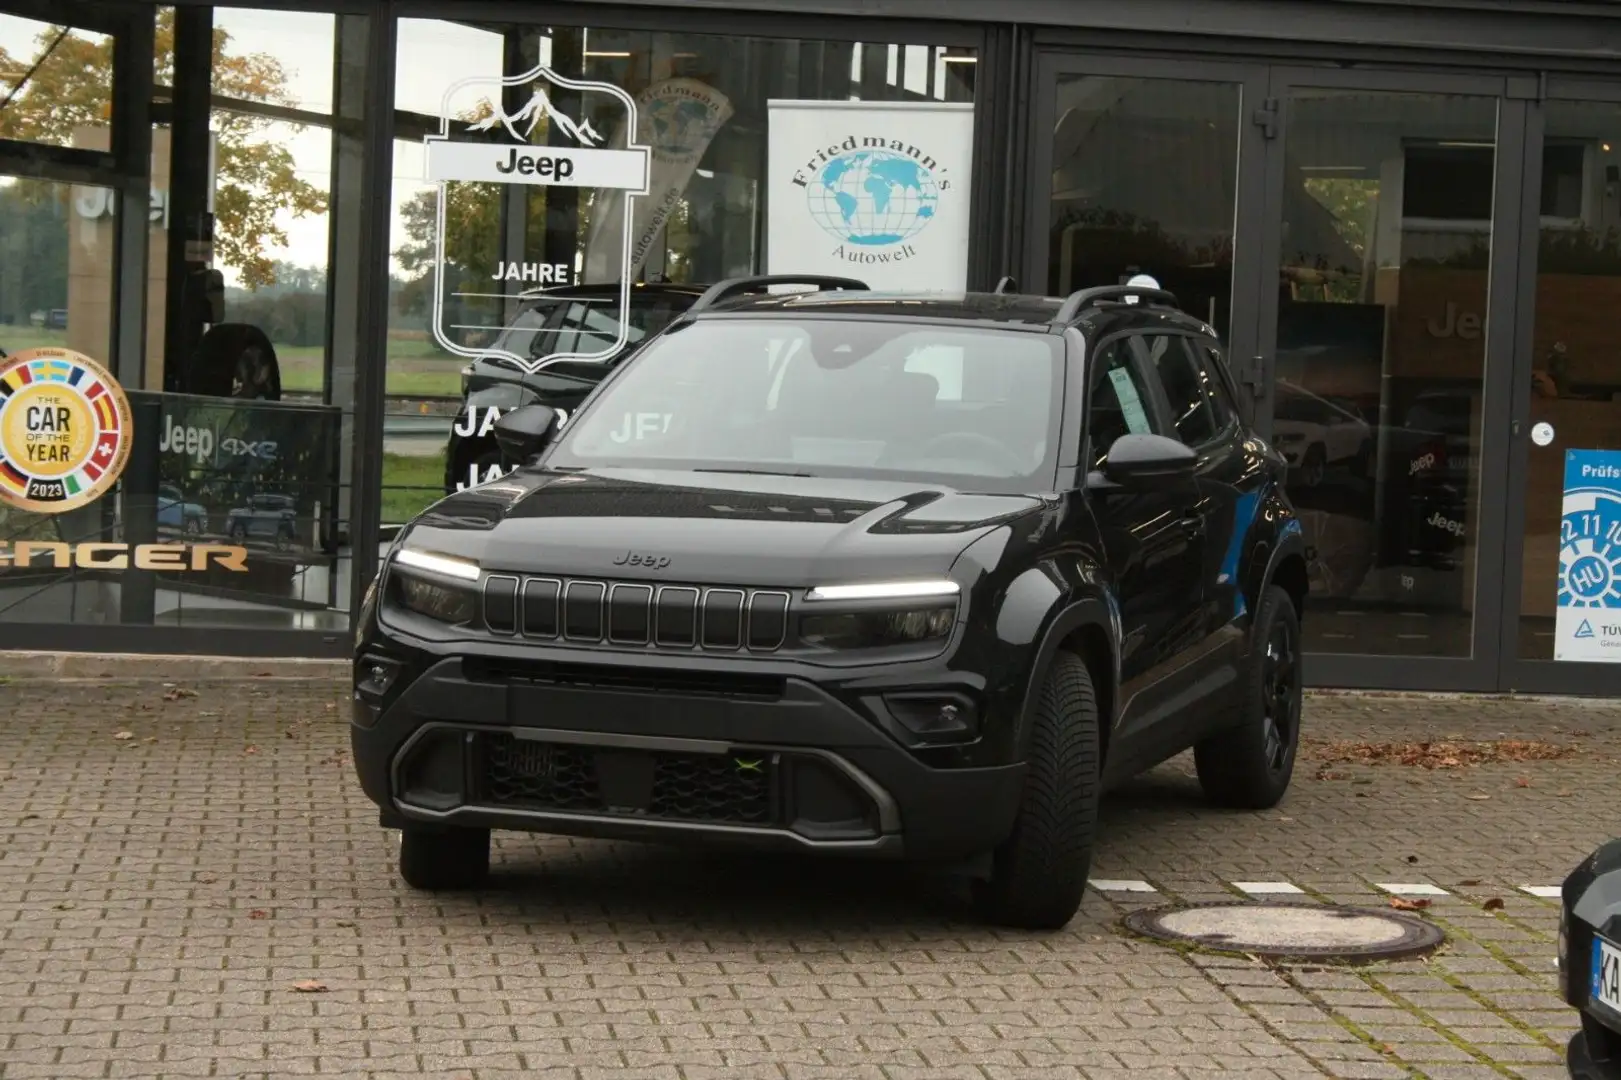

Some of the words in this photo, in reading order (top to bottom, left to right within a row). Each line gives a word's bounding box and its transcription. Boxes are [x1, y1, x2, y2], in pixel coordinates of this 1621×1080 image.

[496, 148, 573, 181] Jeep
[792, 135, 951, 189] Friedmann's
[832, 244, 916, 264] Autowelt
[492, 261, 568, 283] JAHRE
[37, 396, 61, 405] THE
[26, 406, 71, 432] CAR
[26, 433, 42, 442] OF
[45, 434, 70, 443] THE
[159, 414, 213, 464] Jeep
[26, 443, 71, 462] YEAR
[1581, 464, 1621, 478] Prüfs
[31, 483, 63, 499] 2023
[1582, 514, 1601, 536] 11
[0, 541, 249, 572] NGER
[612, 550, 671, 570] Jeep
[1572, 562, 1605, 594] HU
[1601, 950, 1620, 1005] KA
